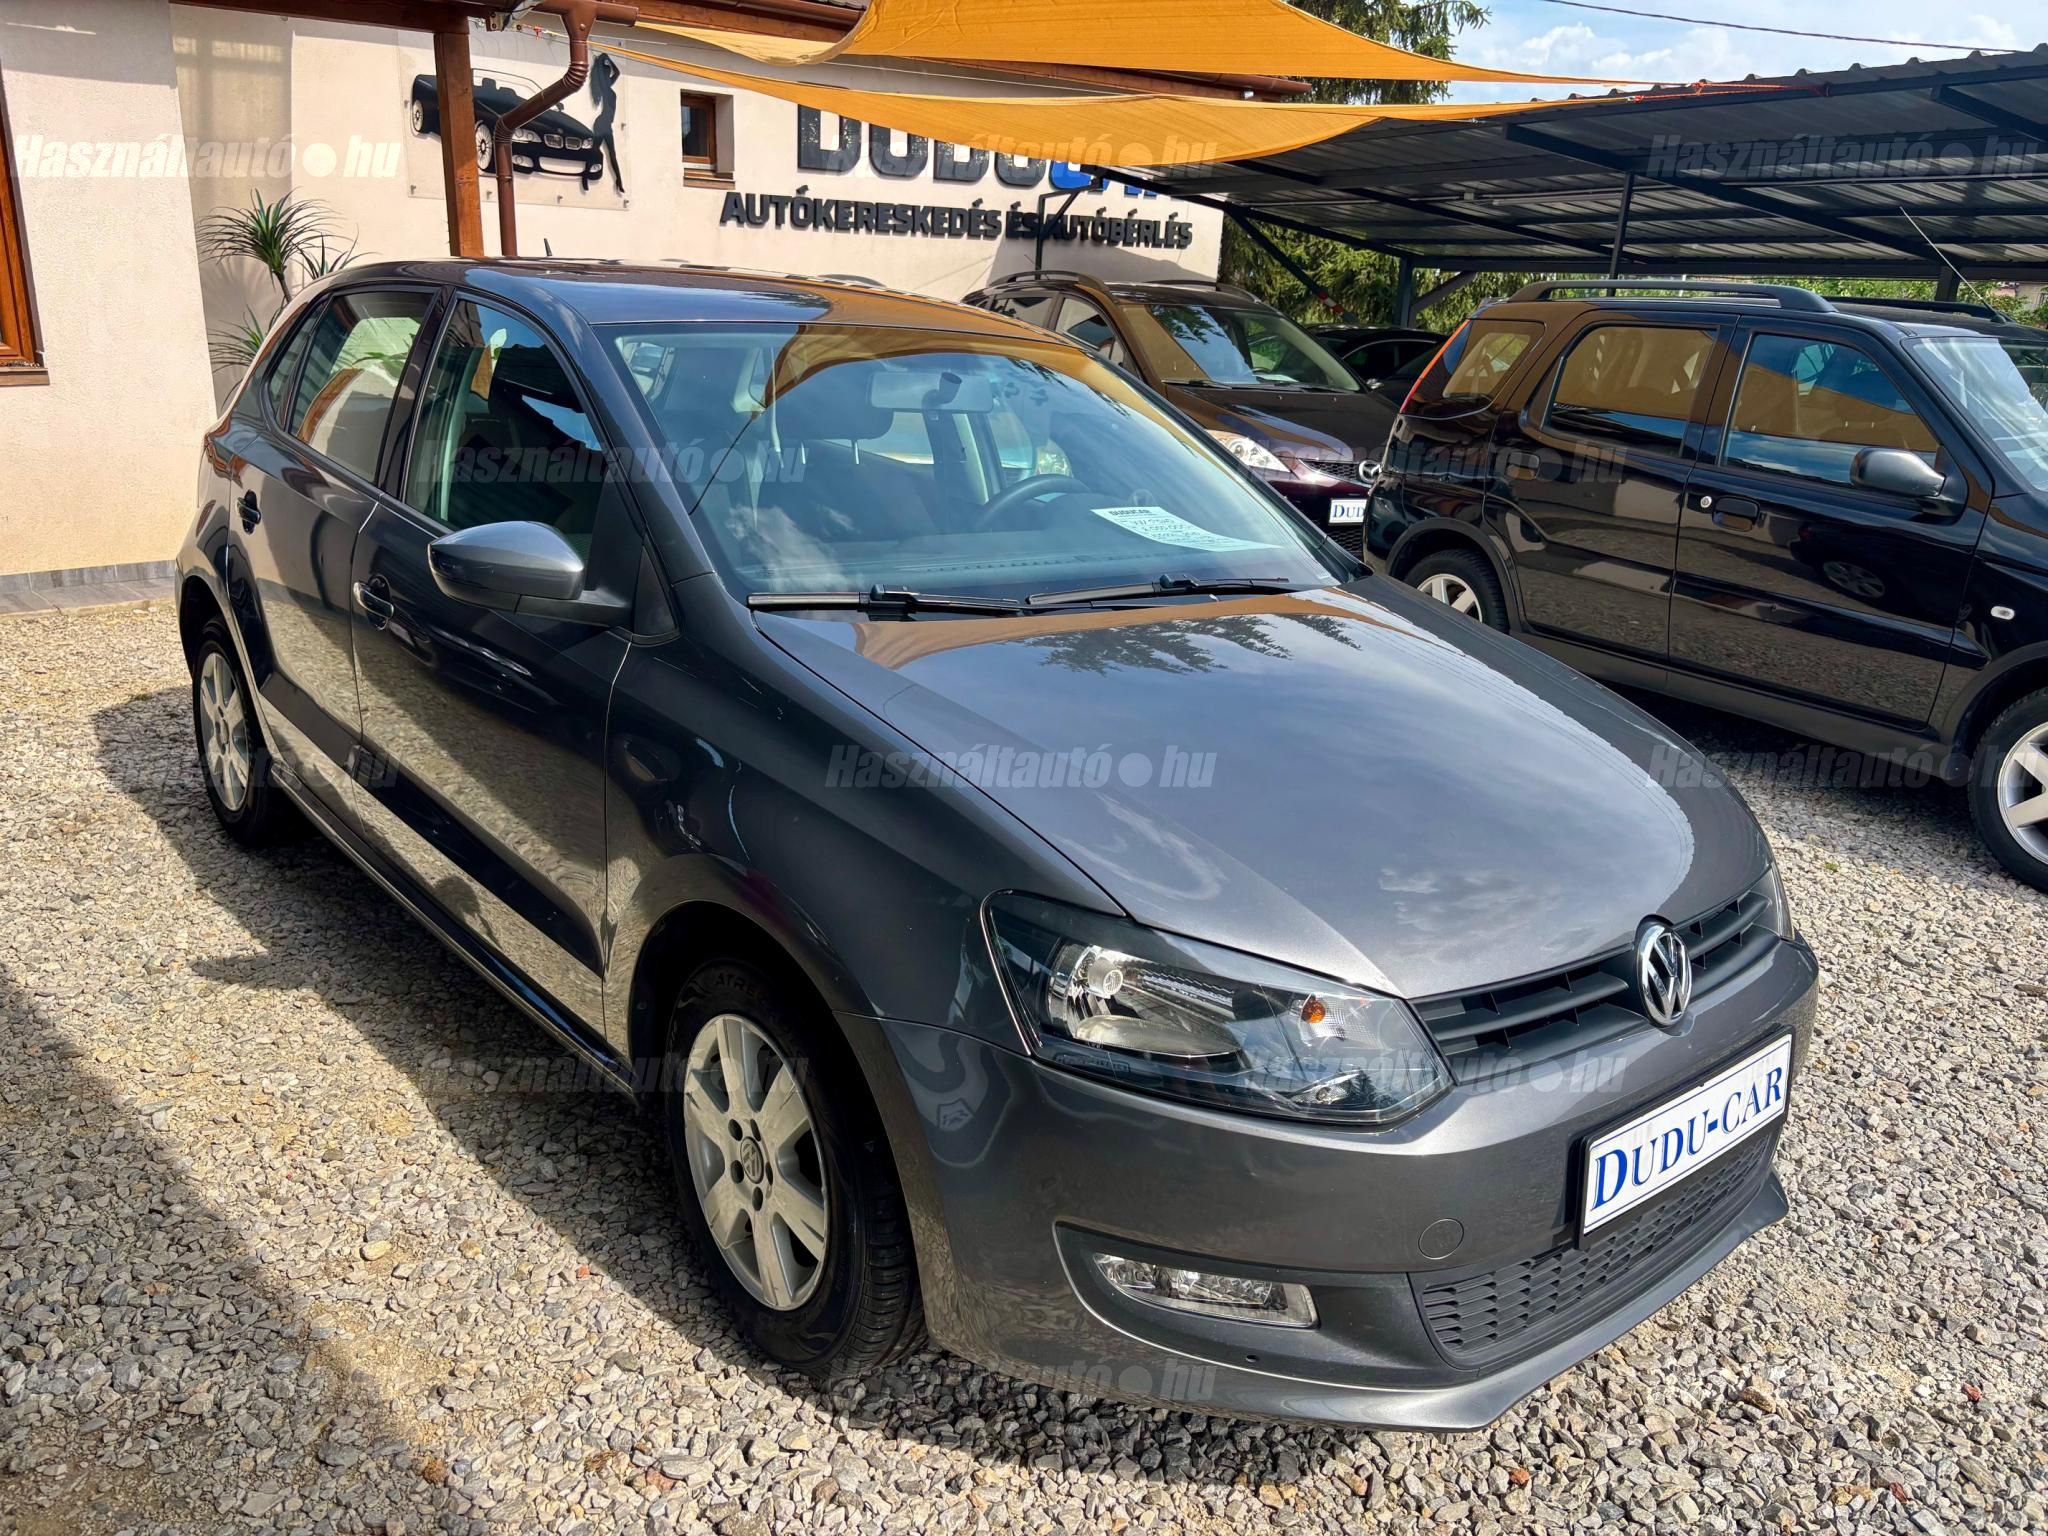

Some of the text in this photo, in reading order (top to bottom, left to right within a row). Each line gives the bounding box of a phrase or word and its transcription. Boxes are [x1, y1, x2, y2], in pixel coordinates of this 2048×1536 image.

[719, 184, 1193, 249] AUTÓKERESKEDÉS ÉS AUTÓBÉRLÉS
[1589, 1066, 1783, 1211] DUDU-CAR
